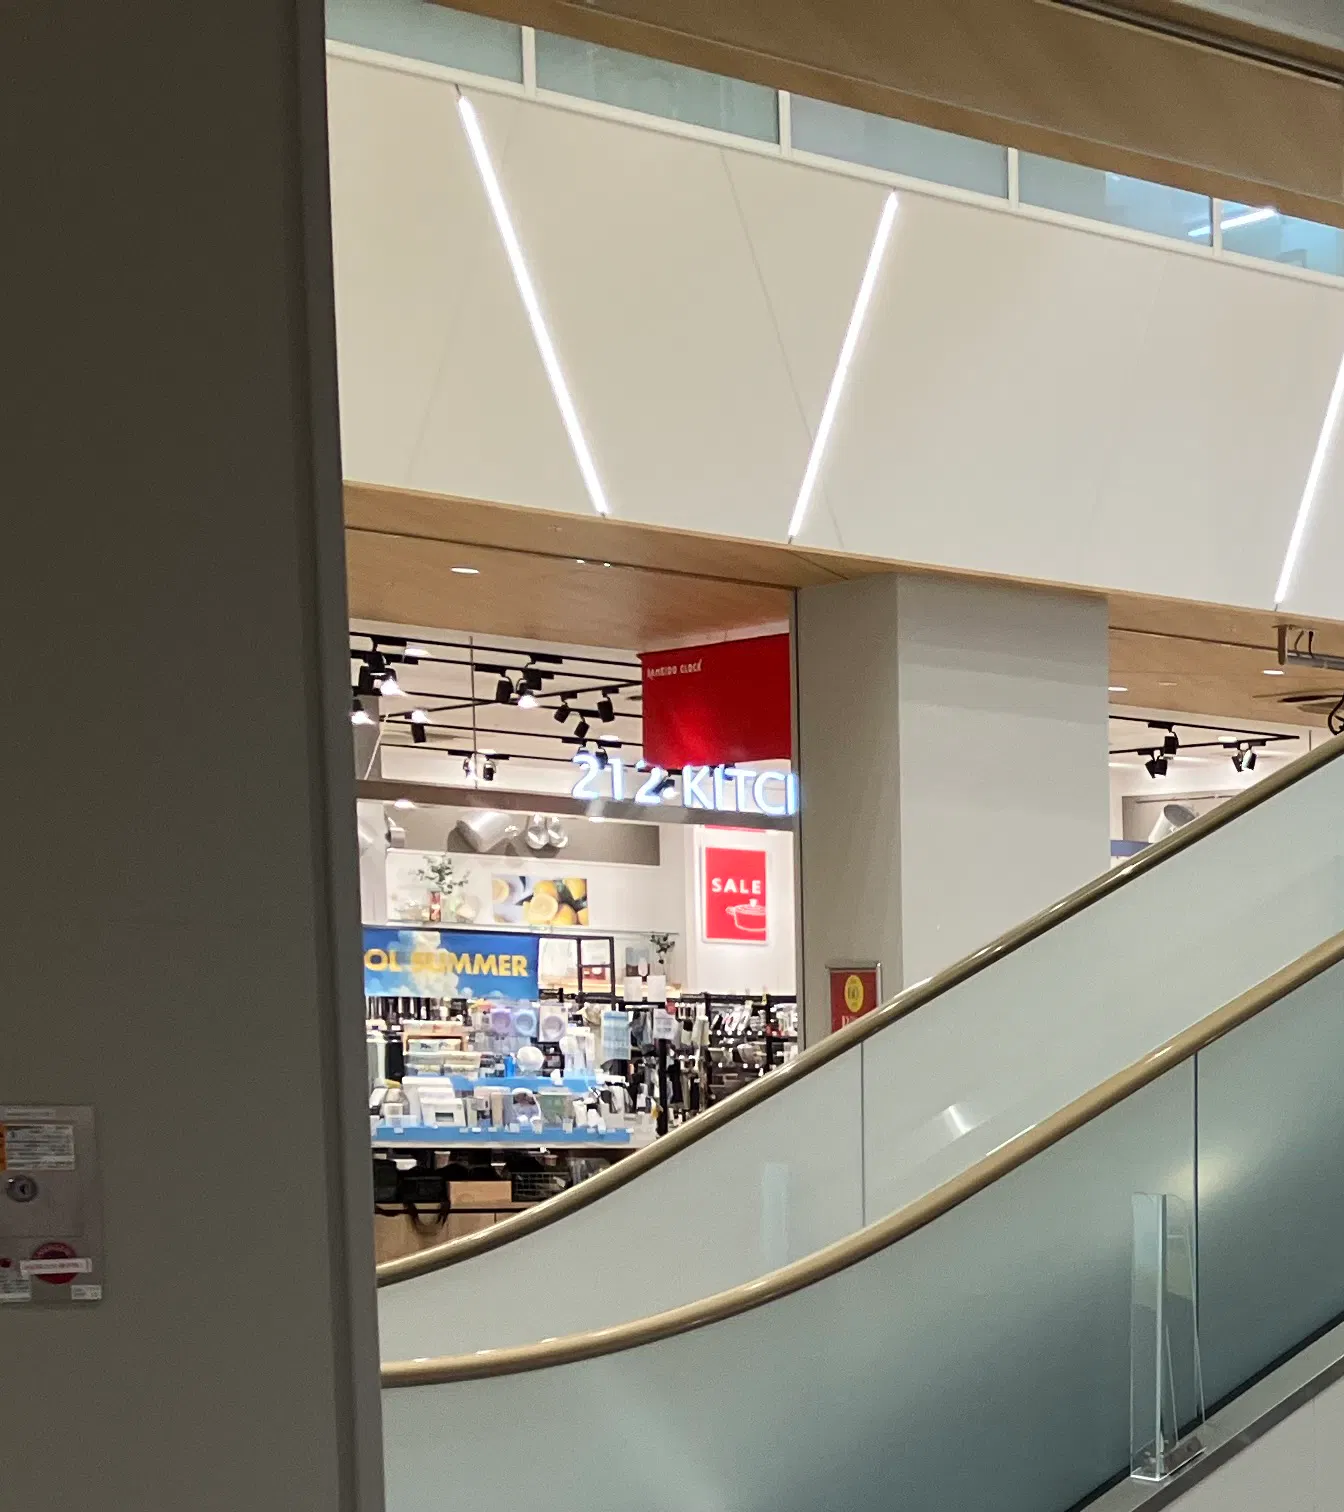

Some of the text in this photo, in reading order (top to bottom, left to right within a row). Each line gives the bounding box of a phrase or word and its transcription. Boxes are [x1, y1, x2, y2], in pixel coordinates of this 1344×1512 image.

[572, 753, 669, 804] 212
[711, 877, 762, 895] SALE
[411, 951, 529, 977] SUMMER
